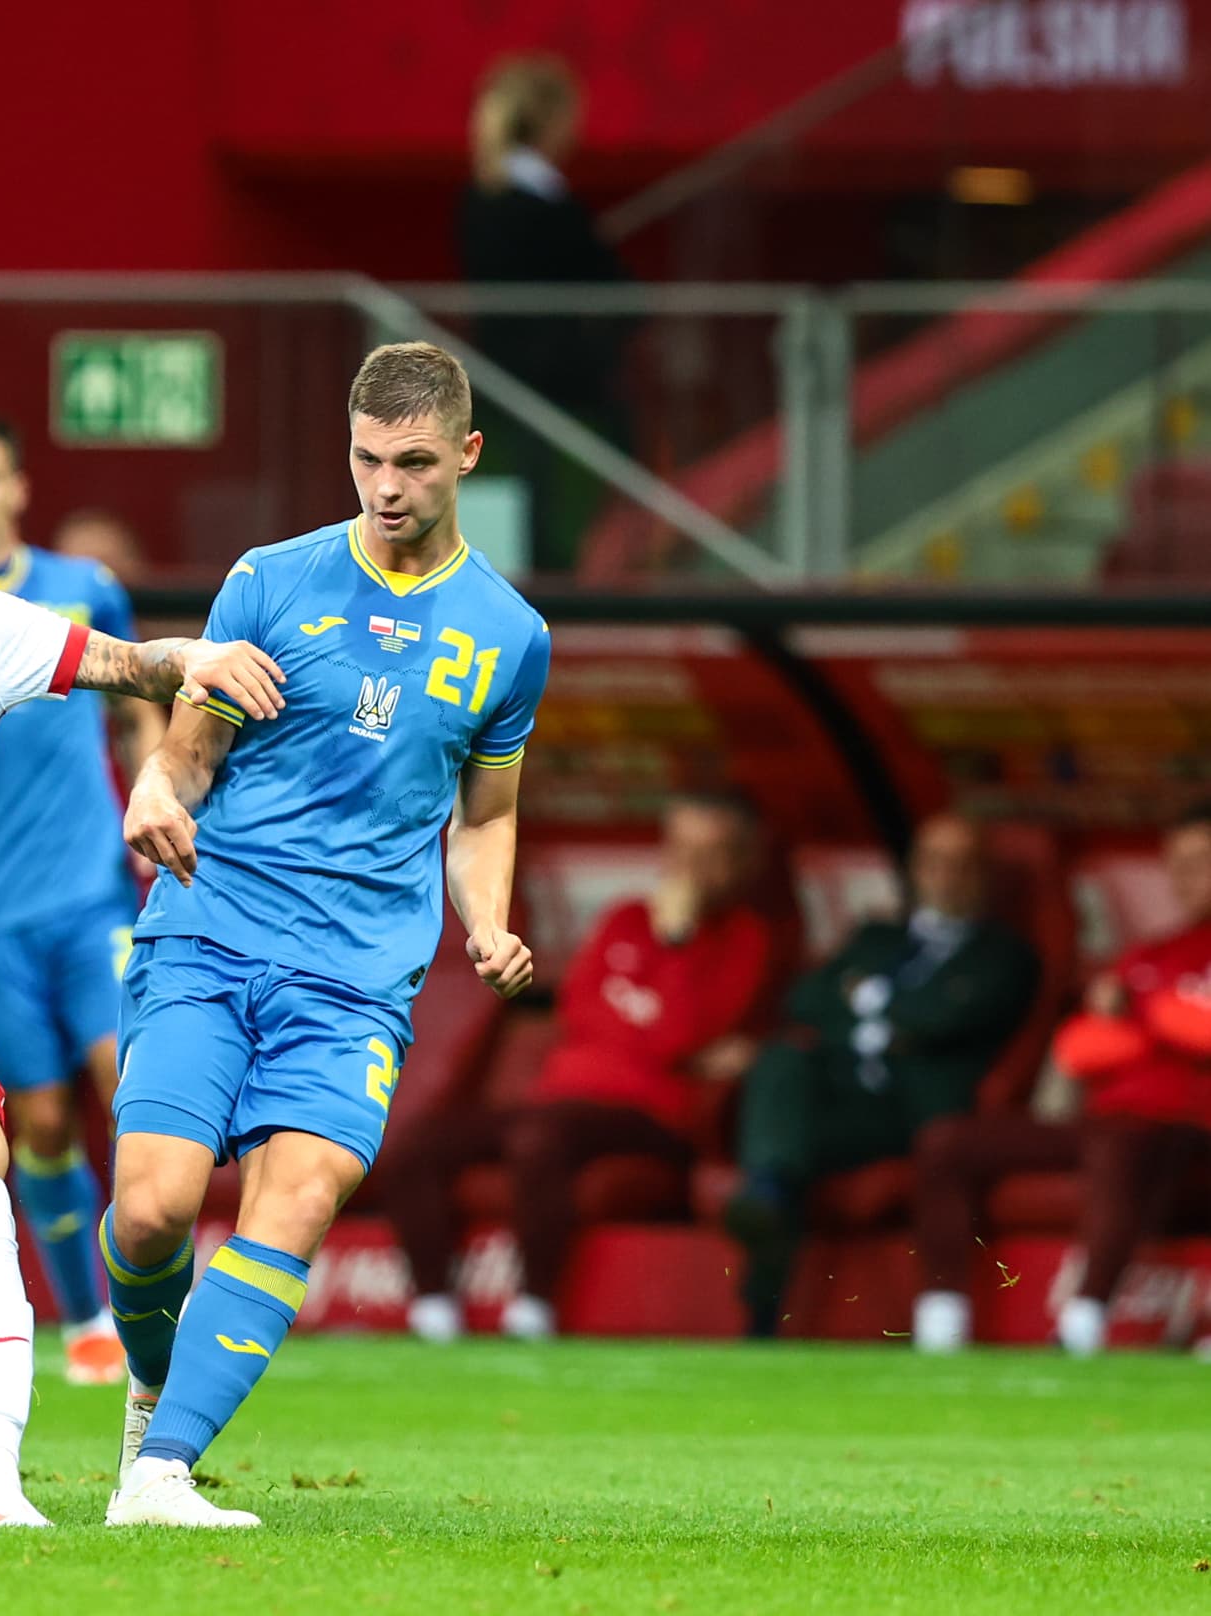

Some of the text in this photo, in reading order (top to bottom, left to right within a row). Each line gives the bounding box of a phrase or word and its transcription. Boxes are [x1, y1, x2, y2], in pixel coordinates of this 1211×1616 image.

[425, 627, 501, 714] 21
[349, 724, 386, 743] UKRAINE
[366, 1036, 399, 1114] 2
